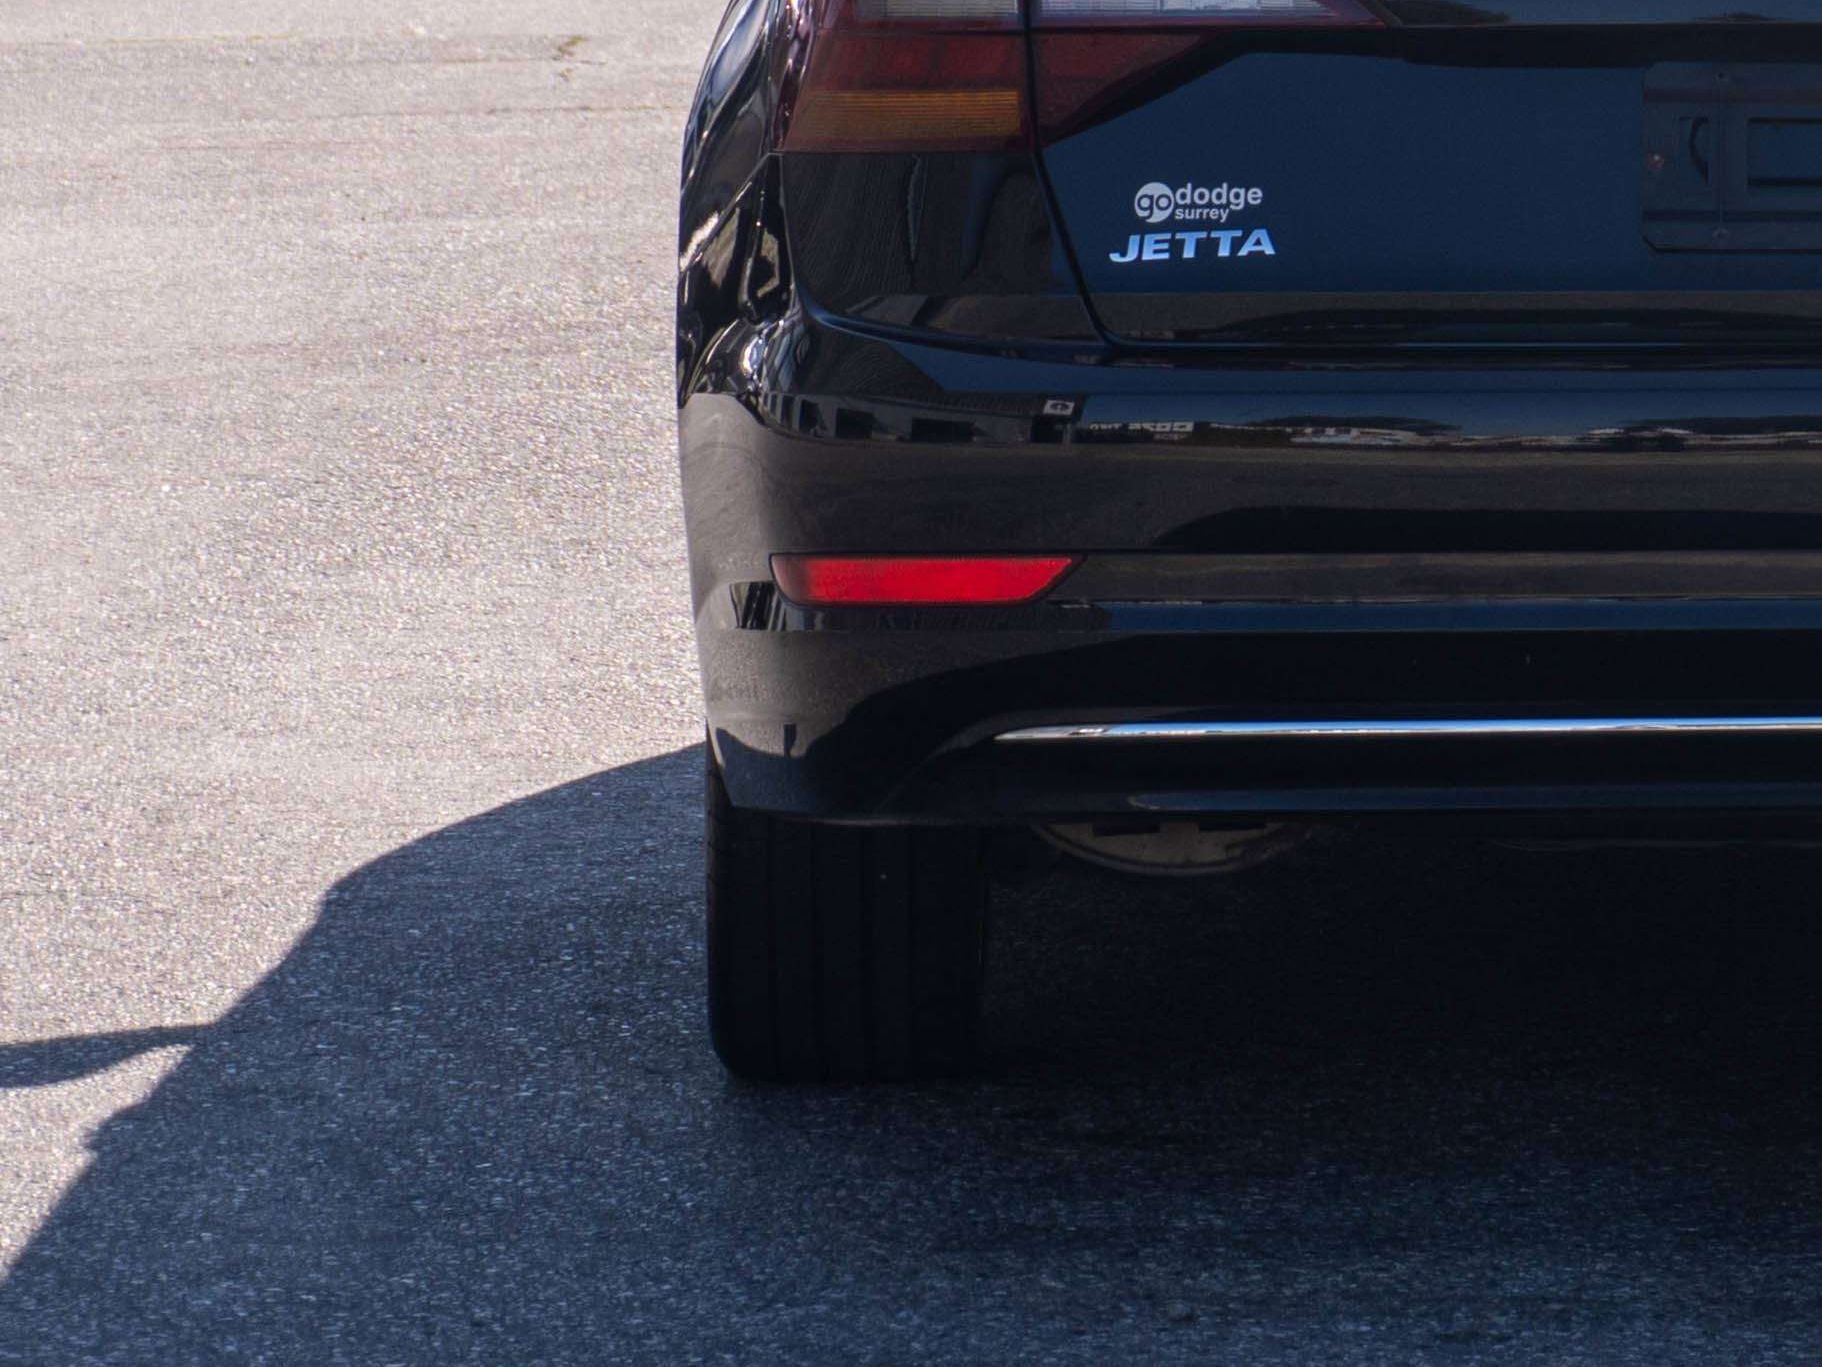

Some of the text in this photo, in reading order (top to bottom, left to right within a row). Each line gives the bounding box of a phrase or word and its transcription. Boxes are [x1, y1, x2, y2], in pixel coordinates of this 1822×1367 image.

[1175, 182, 1263, 210] dodge
[1175, 207, 1230, 223] surrey
[1109, 228, 1276, 263] JETTA
